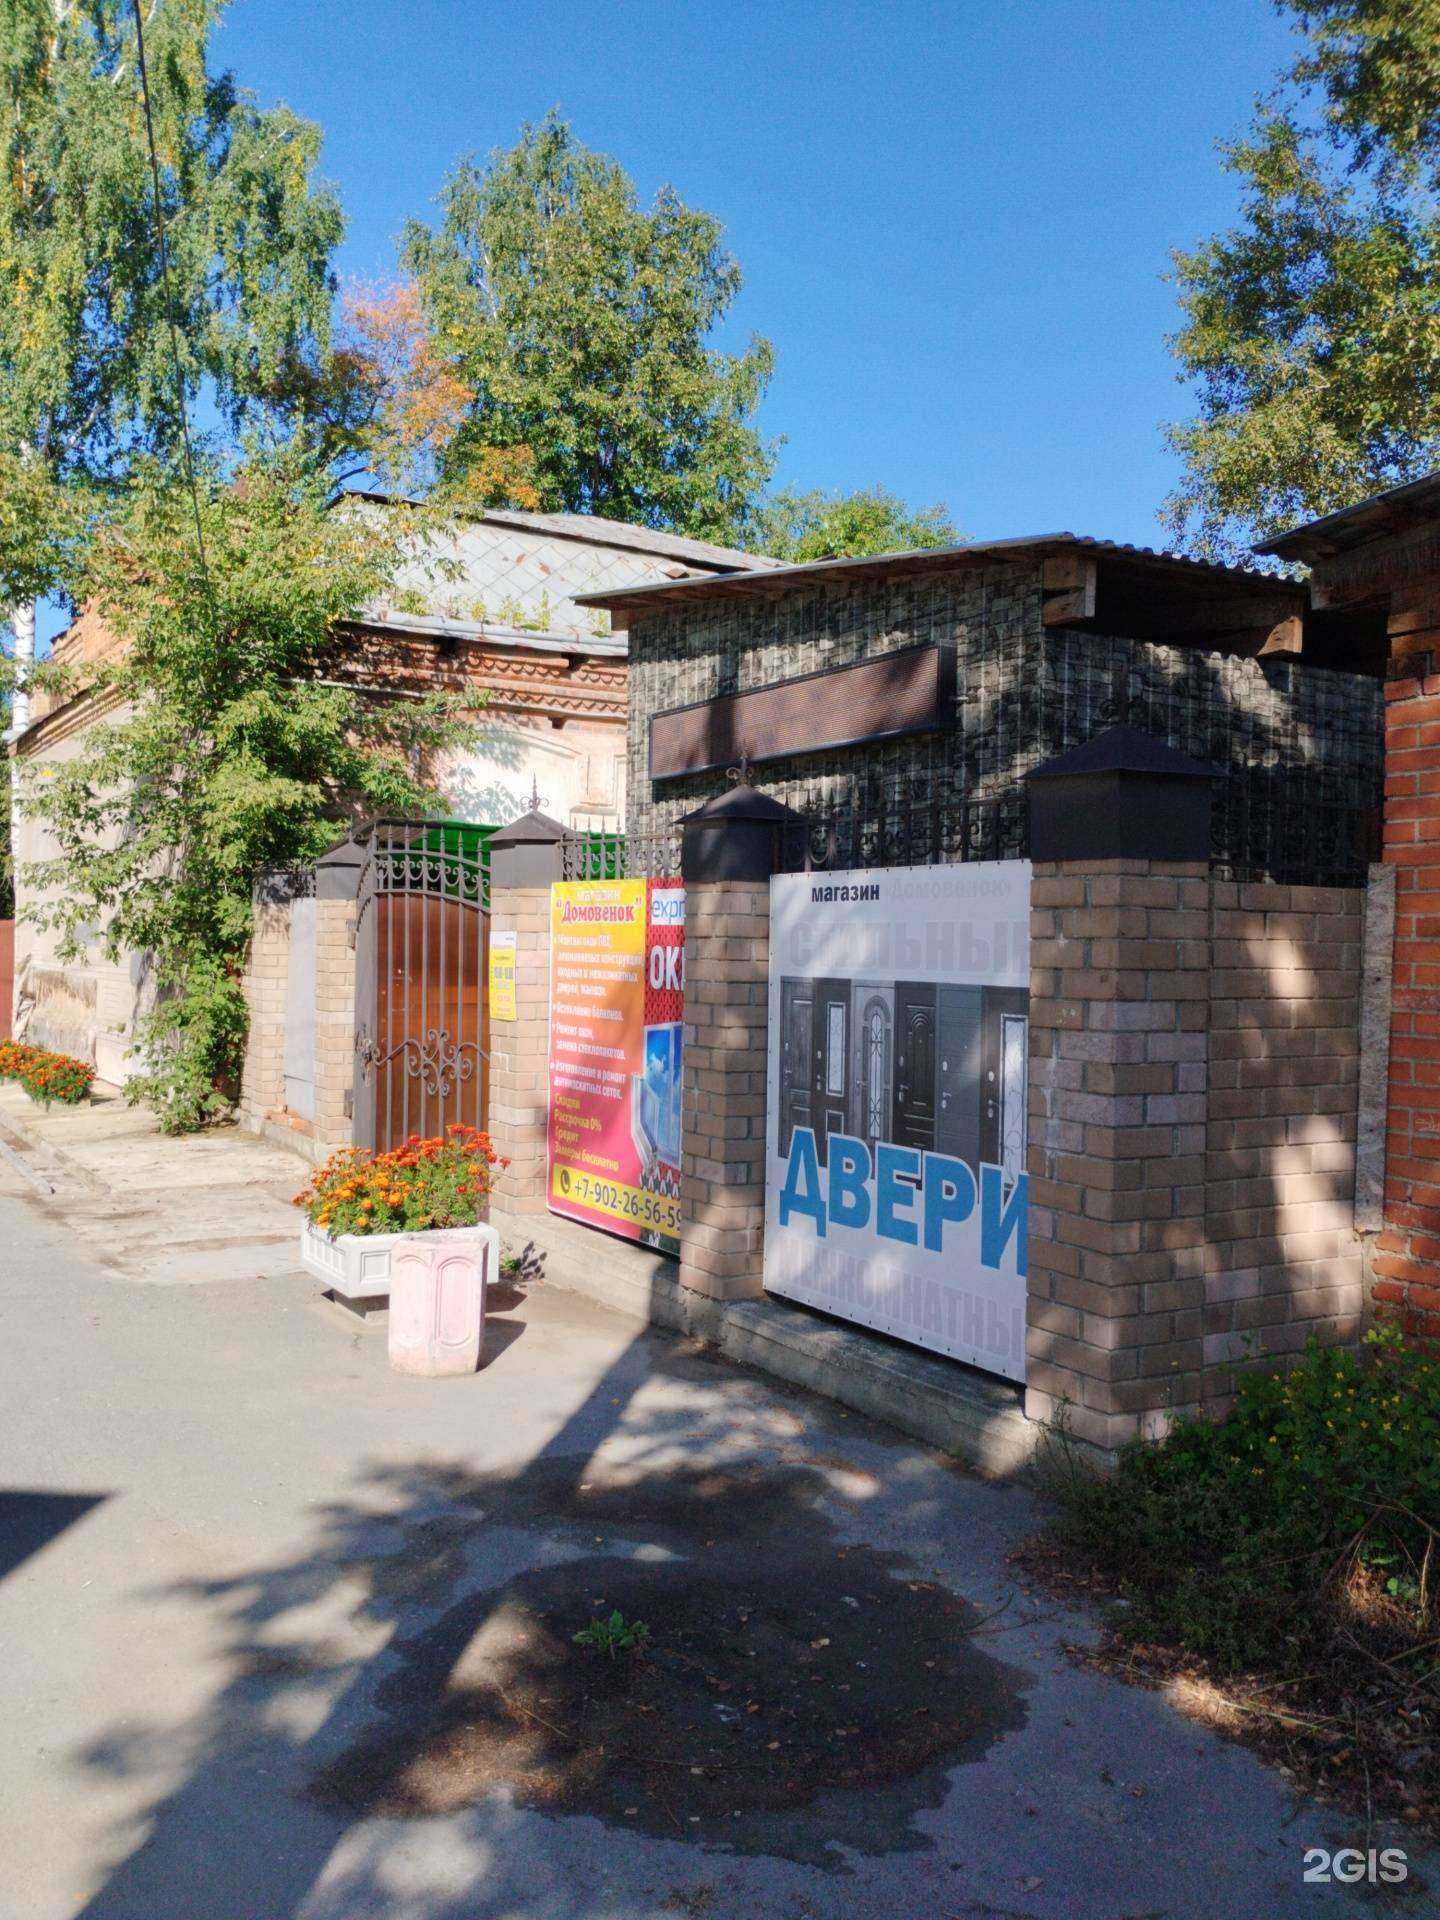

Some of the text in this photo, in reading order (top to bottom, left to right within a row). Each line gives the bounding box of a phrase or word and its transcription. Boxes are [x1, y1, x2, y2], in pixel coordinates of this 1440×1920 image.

[811, 884, 880, 903] магазин
[554, 1093, 580, 1110] Скидки
[554, 1108, 590, 1128] Рассрочка
[555, 1126, 580, 1142] Кредит
[554, 1141, 620, 1171] Замеры бесплатно
[779, 1126, 1028, 1278] ДВЕРИ
